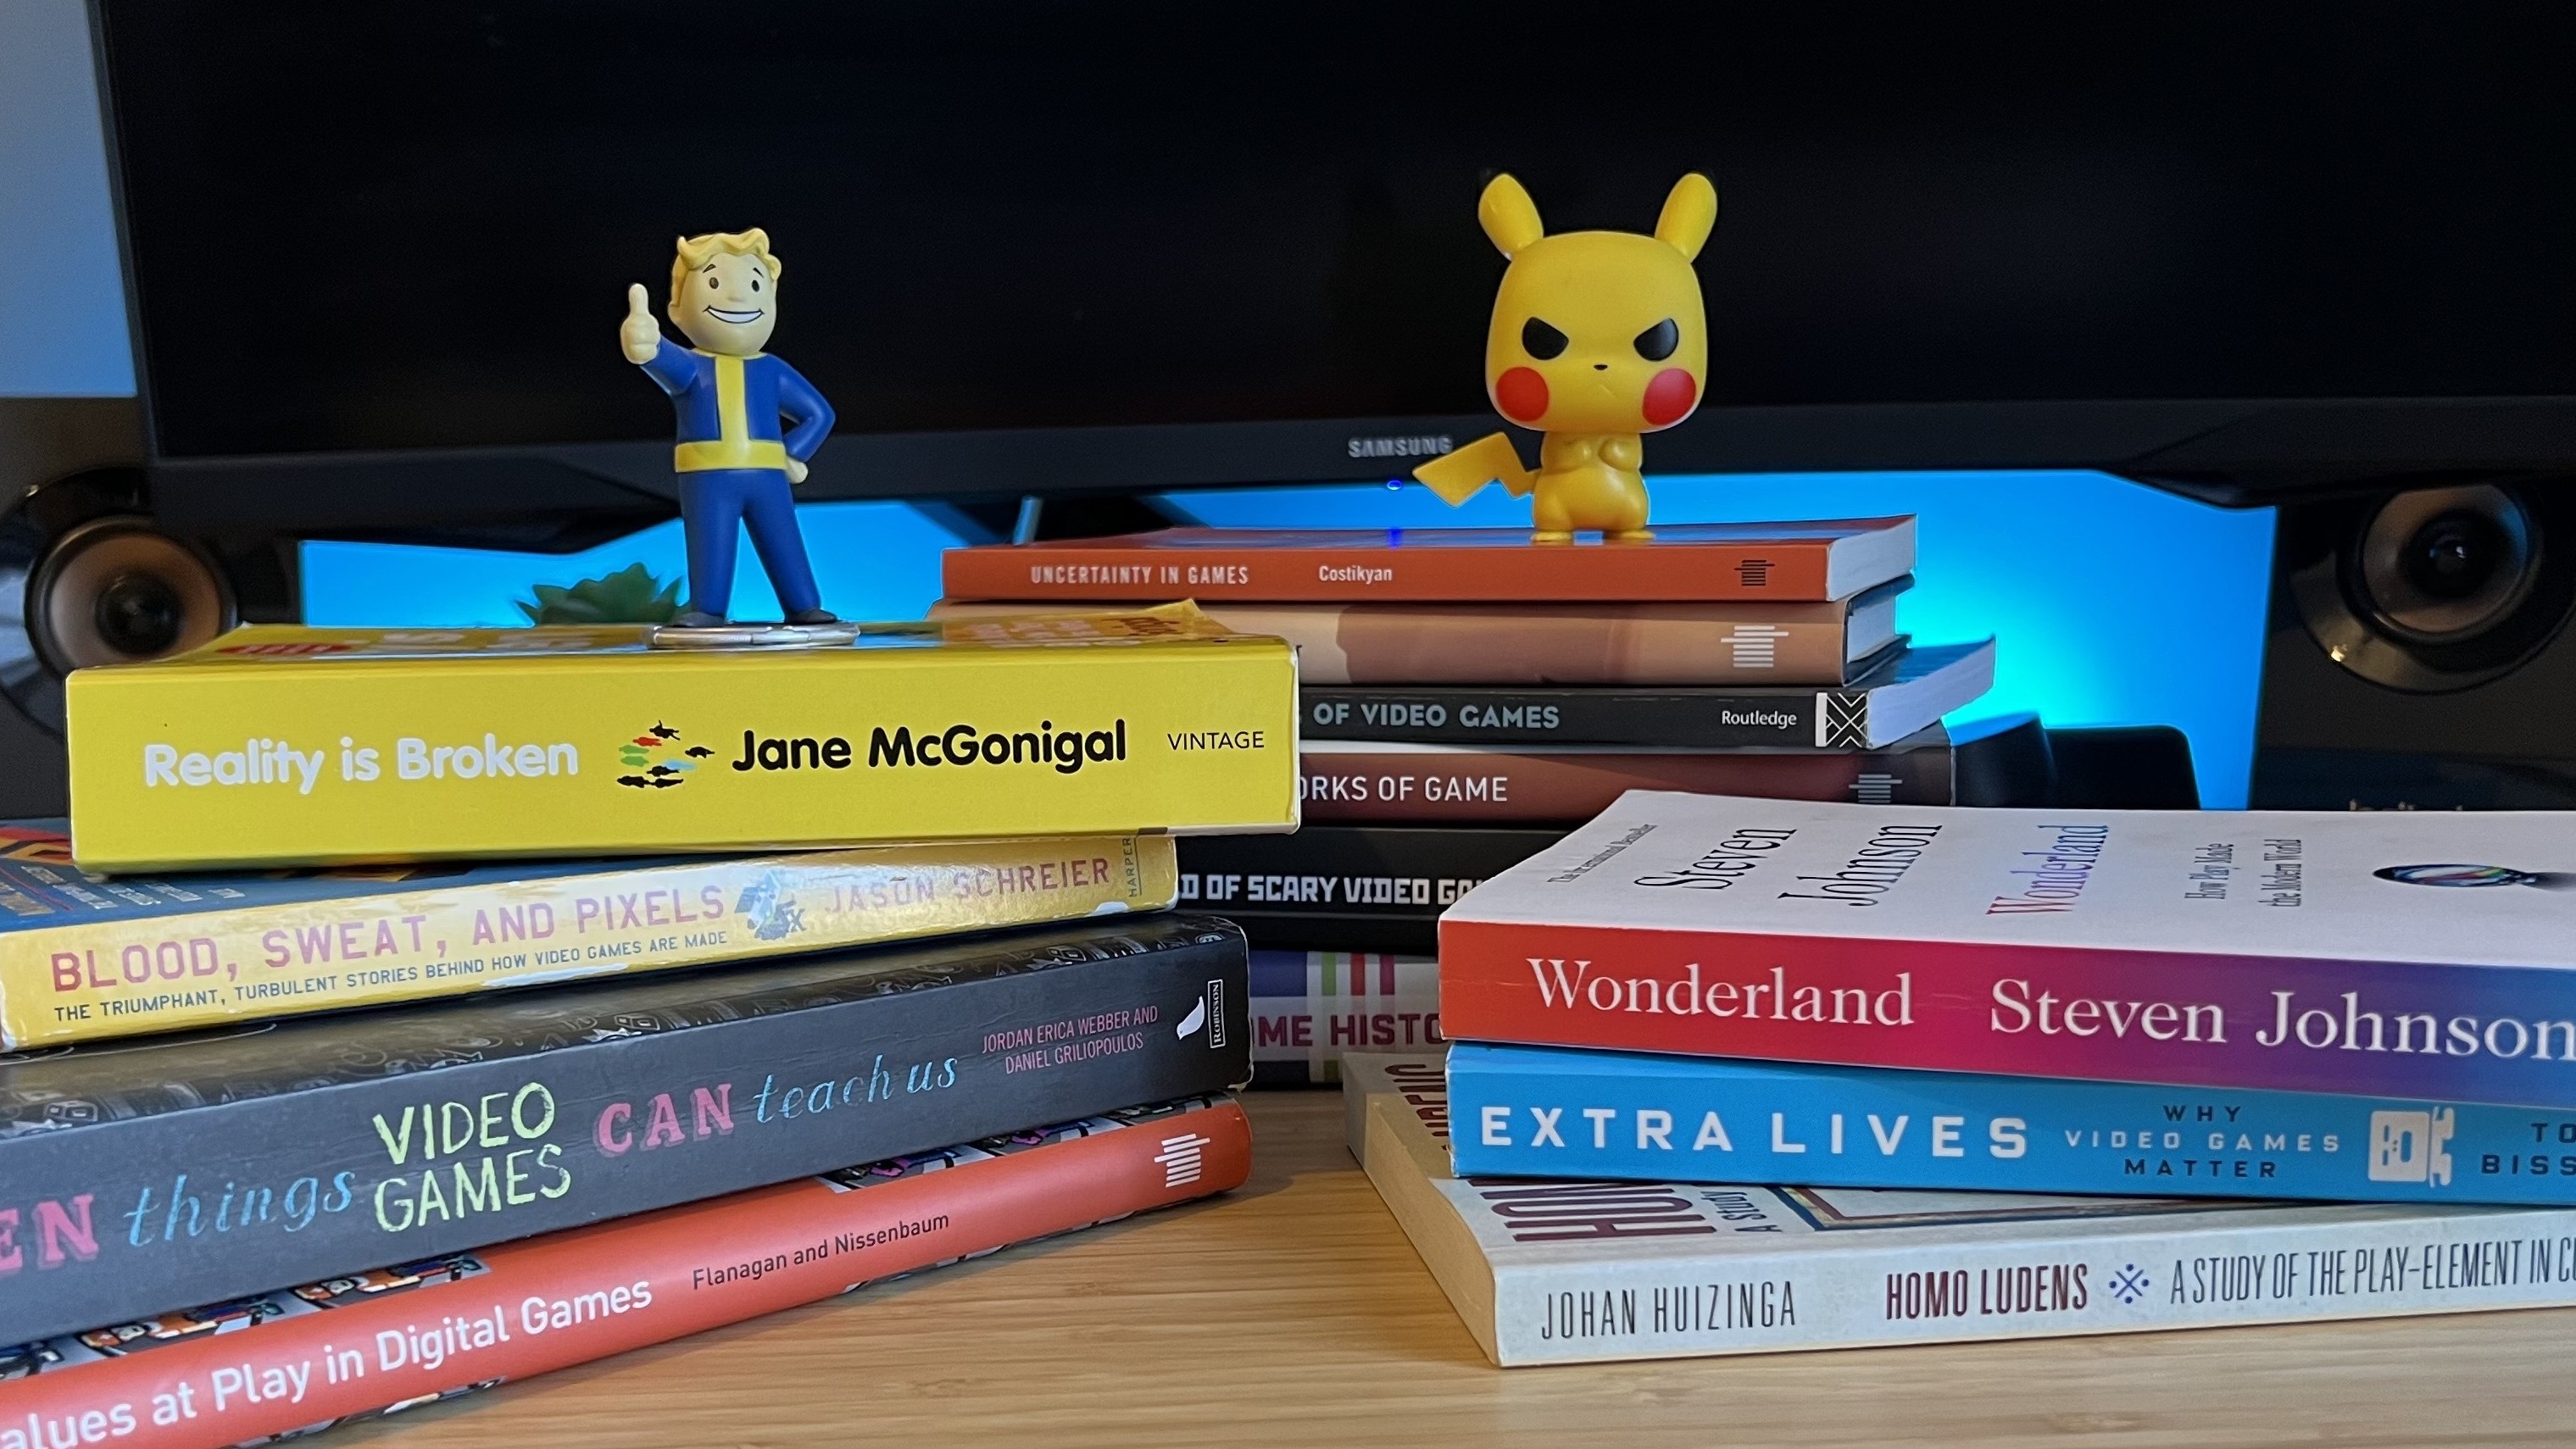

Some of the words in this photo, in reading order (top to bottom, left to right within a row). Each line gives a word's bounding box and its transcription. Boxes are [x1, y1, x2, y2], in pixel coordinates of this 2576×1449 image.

[1348, 436, 1452, 458] SAMSUNG
[1030, 566, 1152, 586] UNCERTAINTY
[1160, 566, 1179, 586] IN
[1188, 566, 1249, 586] GAMES
[1318, 565, 1393, 585] Costikyan
[1313, 702, 1349, 726] OF
[1360, 703, 1447, 728] VIDEO
[1459, 705, 1561, 730] GAMES
[1721, 709, 1798, 730] Routledge
[144, 738, 325, 796] Reality
[341, 736, 381, 782] is
[397, 733, 578, 781] Broken
[732, 730, 852, 772] Jane
[868, 719, 1127, 774] McGonigal
[1166, 730, 1266, 752] VINTAGE
[1378, 776, 1416, 802] OF
[1424, 776, 1509, 802] GAME
[1121, 836, 1138, 898] HARPER
[1206, 874, 1242, 901] OF
[1247, 875, 1338, 903] SCARY
[1344, 877, 1431, 905] VIDEO
[1633, 828, 1798, 890] Steven
[1777, 824, 1943, 907] Johnson
[1984, 824, 2110, 915] Wonderland
[51, 936, 238, 992] BLOOD,
[263, 915, 448, 969] SWEAT,
[470, 902, 555, 947] AND
[576, 885, 724, 935] PIXELS
[824, 875, 935, 915] JASON
[953, 858, 1110, 899] SCHREIER
[54, 1004, 92, 1023] THE
[100, 990, 226, 1018] TRIUMPHANT,
[234, 975, 337, 1001] TURBULENT
[347, 967, 418, 988] STORIES
[425, 958, 485, 980] BEHIND
[491, 953, 528, 971] HOW
[535, 947, 581, 966] VIDEO
[587, 940, 643, 960] GAMES
[648, 937, 679, 953] ARE
[684, 931, 729, 949] MADE
[982, 1027, 1033, 1054] JORDAN
[1037, 1020, 1075, 1044] ERICA
[1077, 1010, 1130, 1035] WEBBER
[1133, 1005, 1159, 1026] AND
[1211, 983, 1222, 1044] ROBINSON
[1525, 958, 1915, 1026] Wonderland
[1990, 978, 2227, 1044] Steven
[2255, 990, 2576, 1062] Johnson
[1004, 1050, 1052, 1074] DANIEL
[1054, 1031, 1144, 1064] GRILIOPOULOS
[1480, 1106, 1733, 1152] EXTRA
[1771, 1112, 2028, 1159] LIVES
[2065, 1129, 2181, 1150] VIDEO
[2208, 1132, 2340, 1153] GAMES
[2162, 1104, 2242, 1123] WHY
[123, 1169, 356, 1247] things
[372, 1081, 556, 1167] VIDEO
[597, 1081, 737, 1158] CAN
[752, 1054, 894, 1124] teach
[907, 1052, 959, 1096] us
[2124, 1158, 2277, 1179] MATTER
[374, 1144, 572, 1233] GAMES
[152, 1381, 198, 1426] at
[211, 1359, 311, 1405] Play
[325, 1342, 366, 1385] in
[378, 1315, 510, 1373] Digital
[520, 1280, 653, 1336] Games
[692, 1250, 788, 1291] Flanagan
[793, 1239, 830, 1264] and
[834, 1210, 950, 1254] Nissenbaum
[1540, 1288, 1637, 1341] JOHAN
[1653, 1280, 1797, 1334] HUIZINGA
[1885, 1269, 1968, 1320] HOMO
[1979, 1262, 2089, 1315] LUDENS
[2170, 1259, 2187, 1305] A
[2191, 1252, 2268, 1305] STUDY
[2272, 1251, 2300, 1300] OF
[2306, 1248, 2348, 1297] THE
[2529, 1237, 2552, 1285] IN
